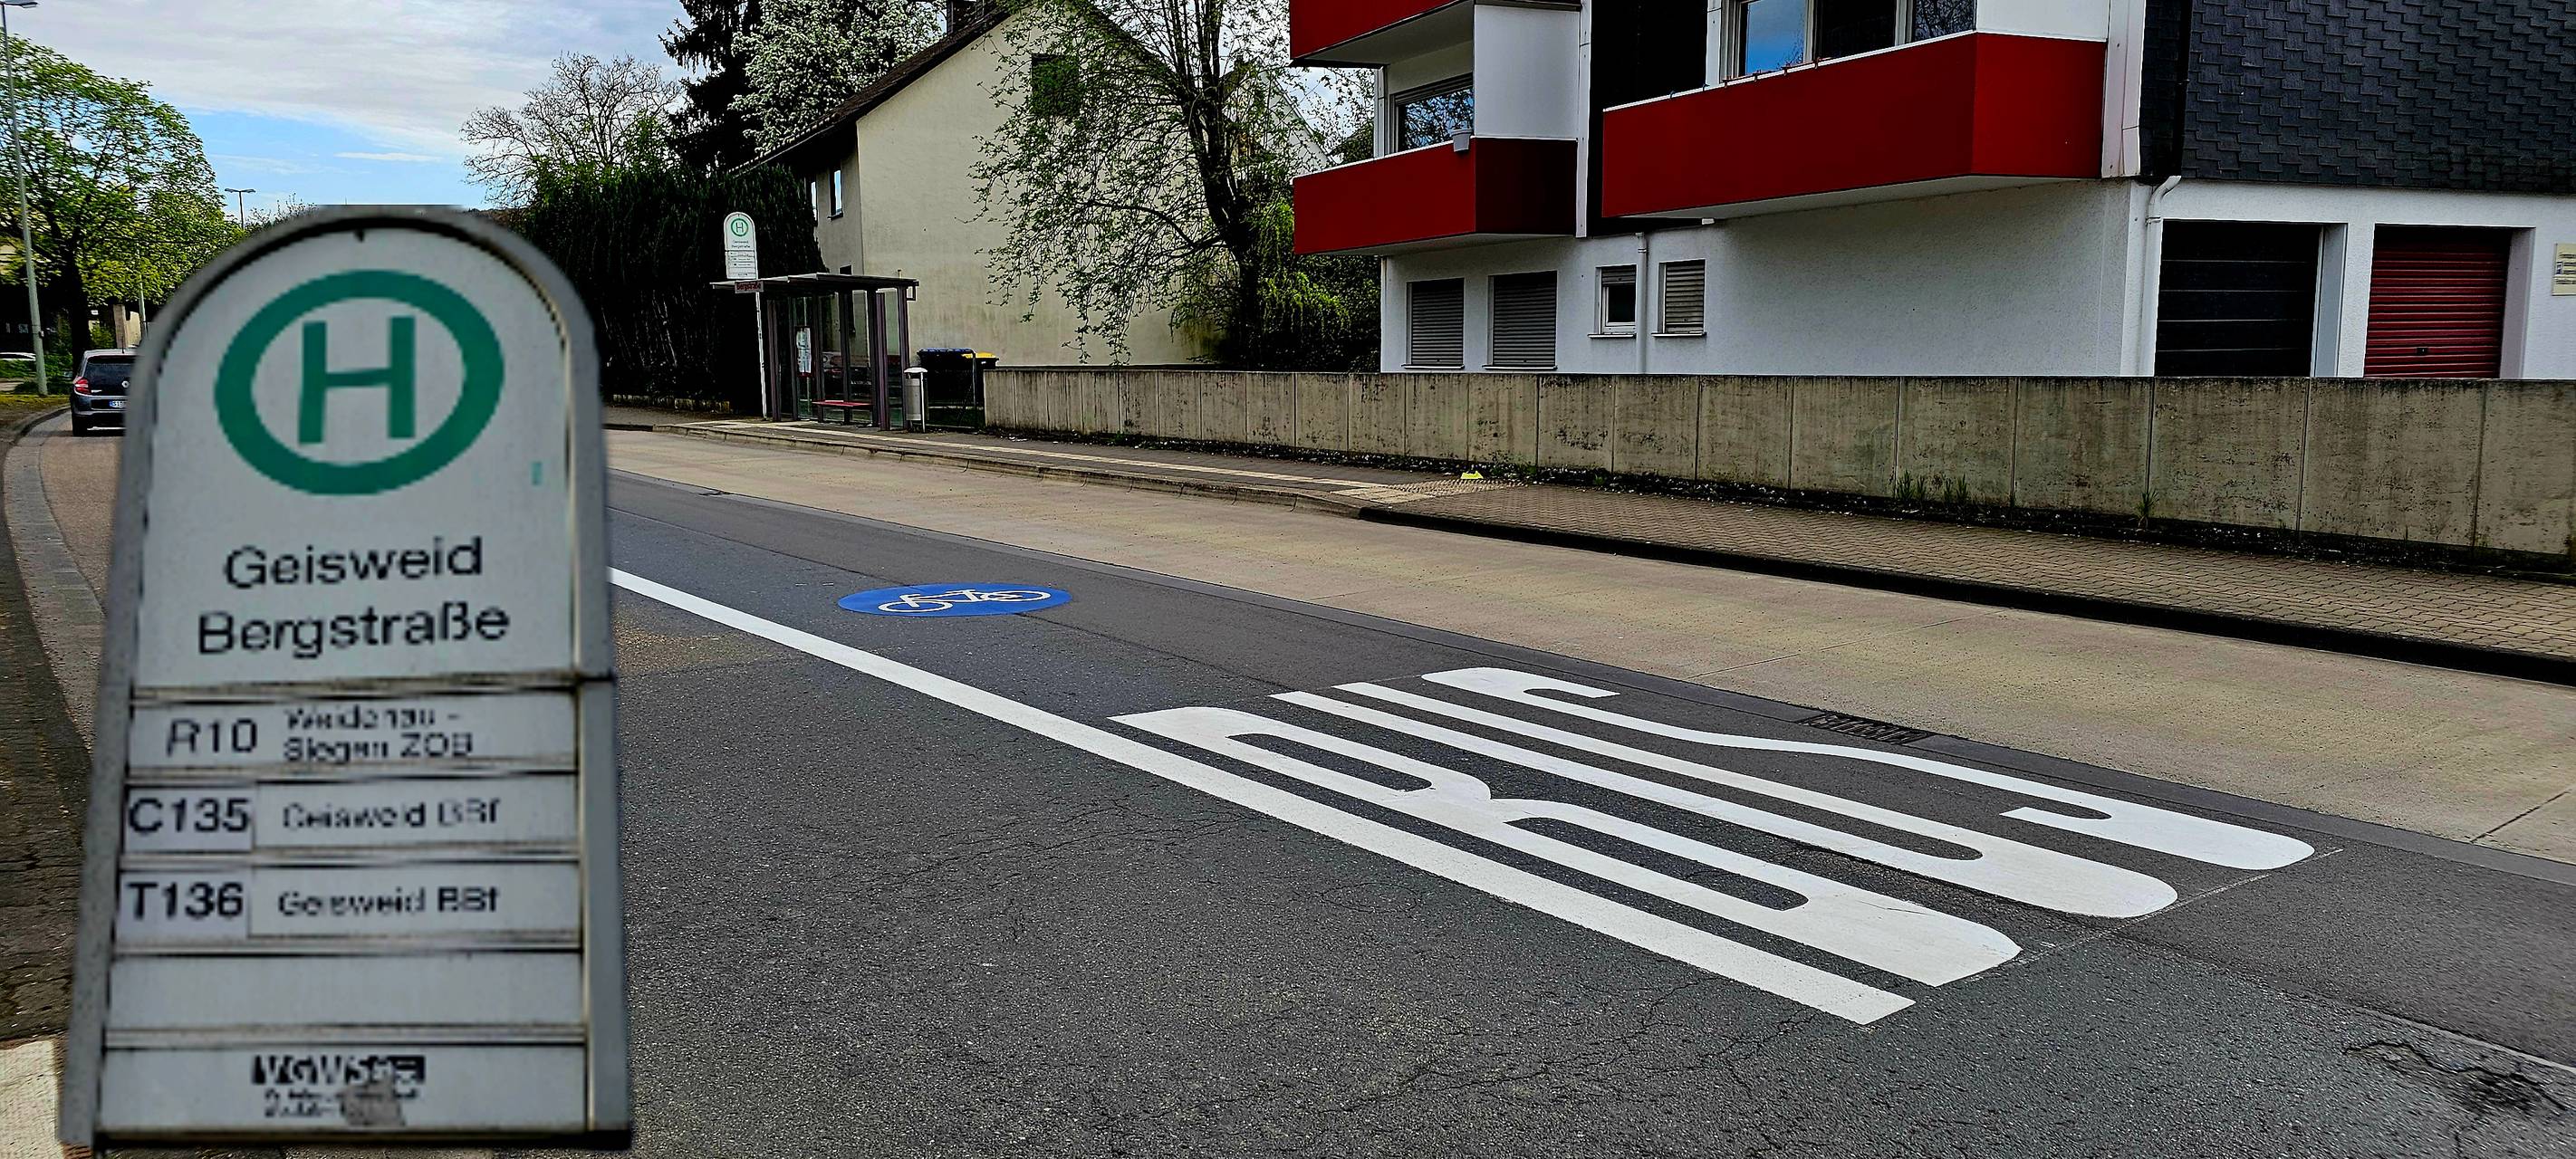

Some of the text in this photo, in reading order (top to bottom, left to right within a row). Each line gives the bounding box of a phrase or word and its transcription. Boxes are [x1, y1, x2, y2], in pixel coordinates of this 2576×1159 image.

[298, 316, 415, 444] H
[225, 536, 483, 589] Geisweid
[198, 601, 510, 659] Bergstraße
[166, 719, 257, 757] R10
[400, 733, 473, 758] ZOB
[129, 798, 250, 834] C135
[1110, 666, 2316, 987] BUS
[126, 882, 244, 919] T136
